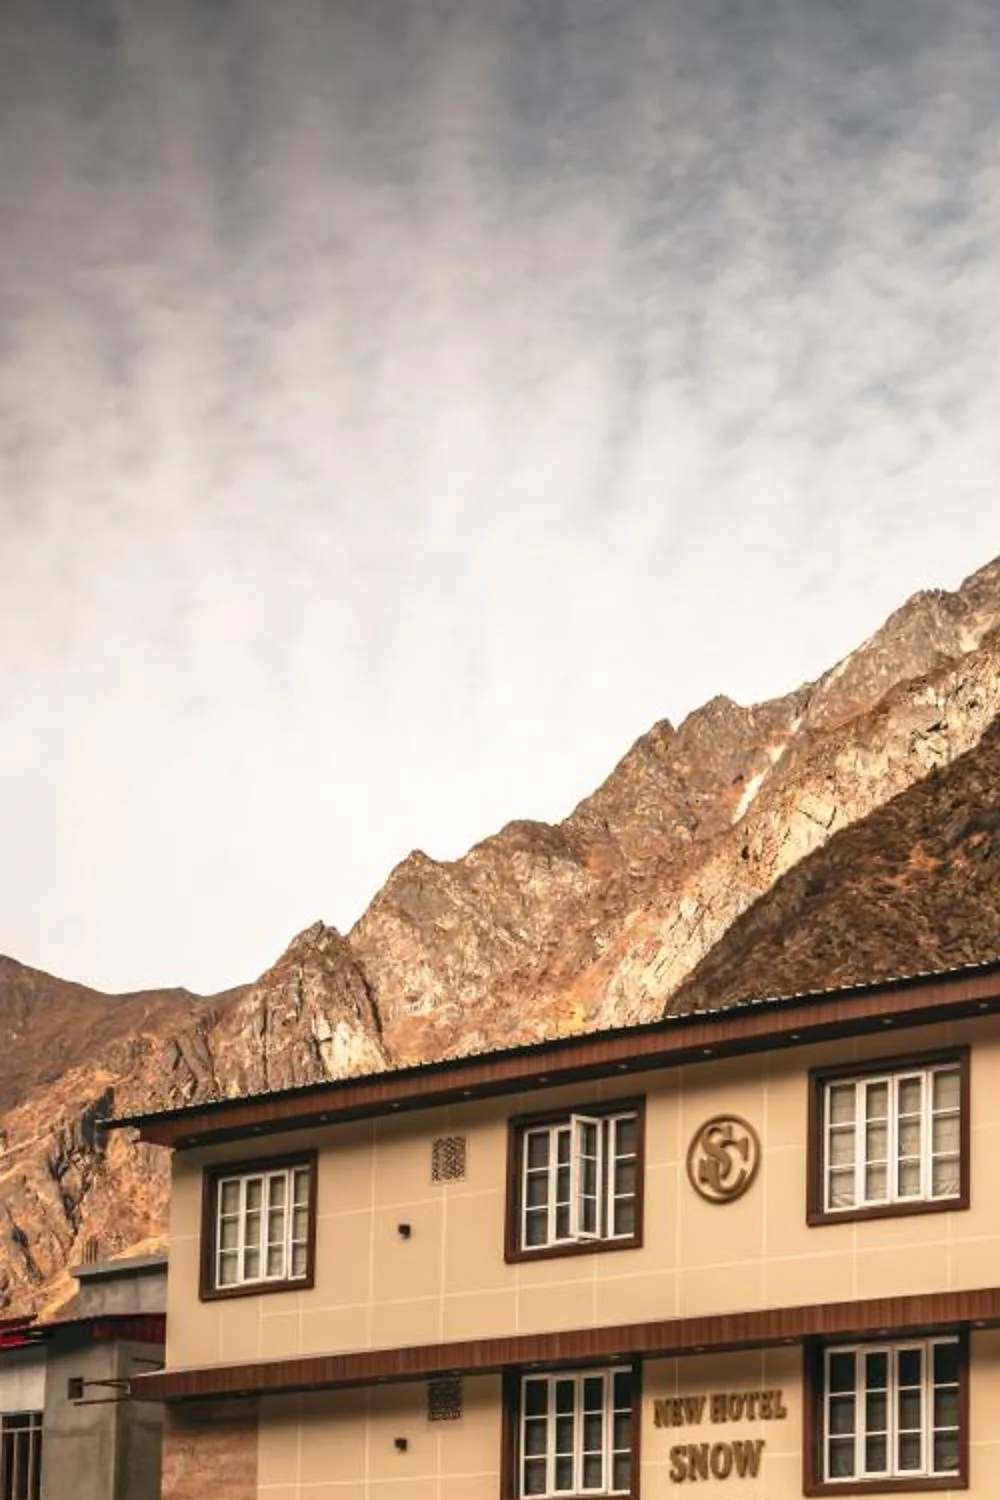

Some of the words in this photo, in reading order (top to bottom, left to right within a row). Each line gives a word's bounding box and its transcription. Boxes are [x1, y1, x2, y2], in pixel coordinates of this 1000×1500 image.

[653, 1396, 707, 1429] NEW
[709, 1389, 788, 1424] HOTEL
[669, 1439, 766, 1484] SNOW
